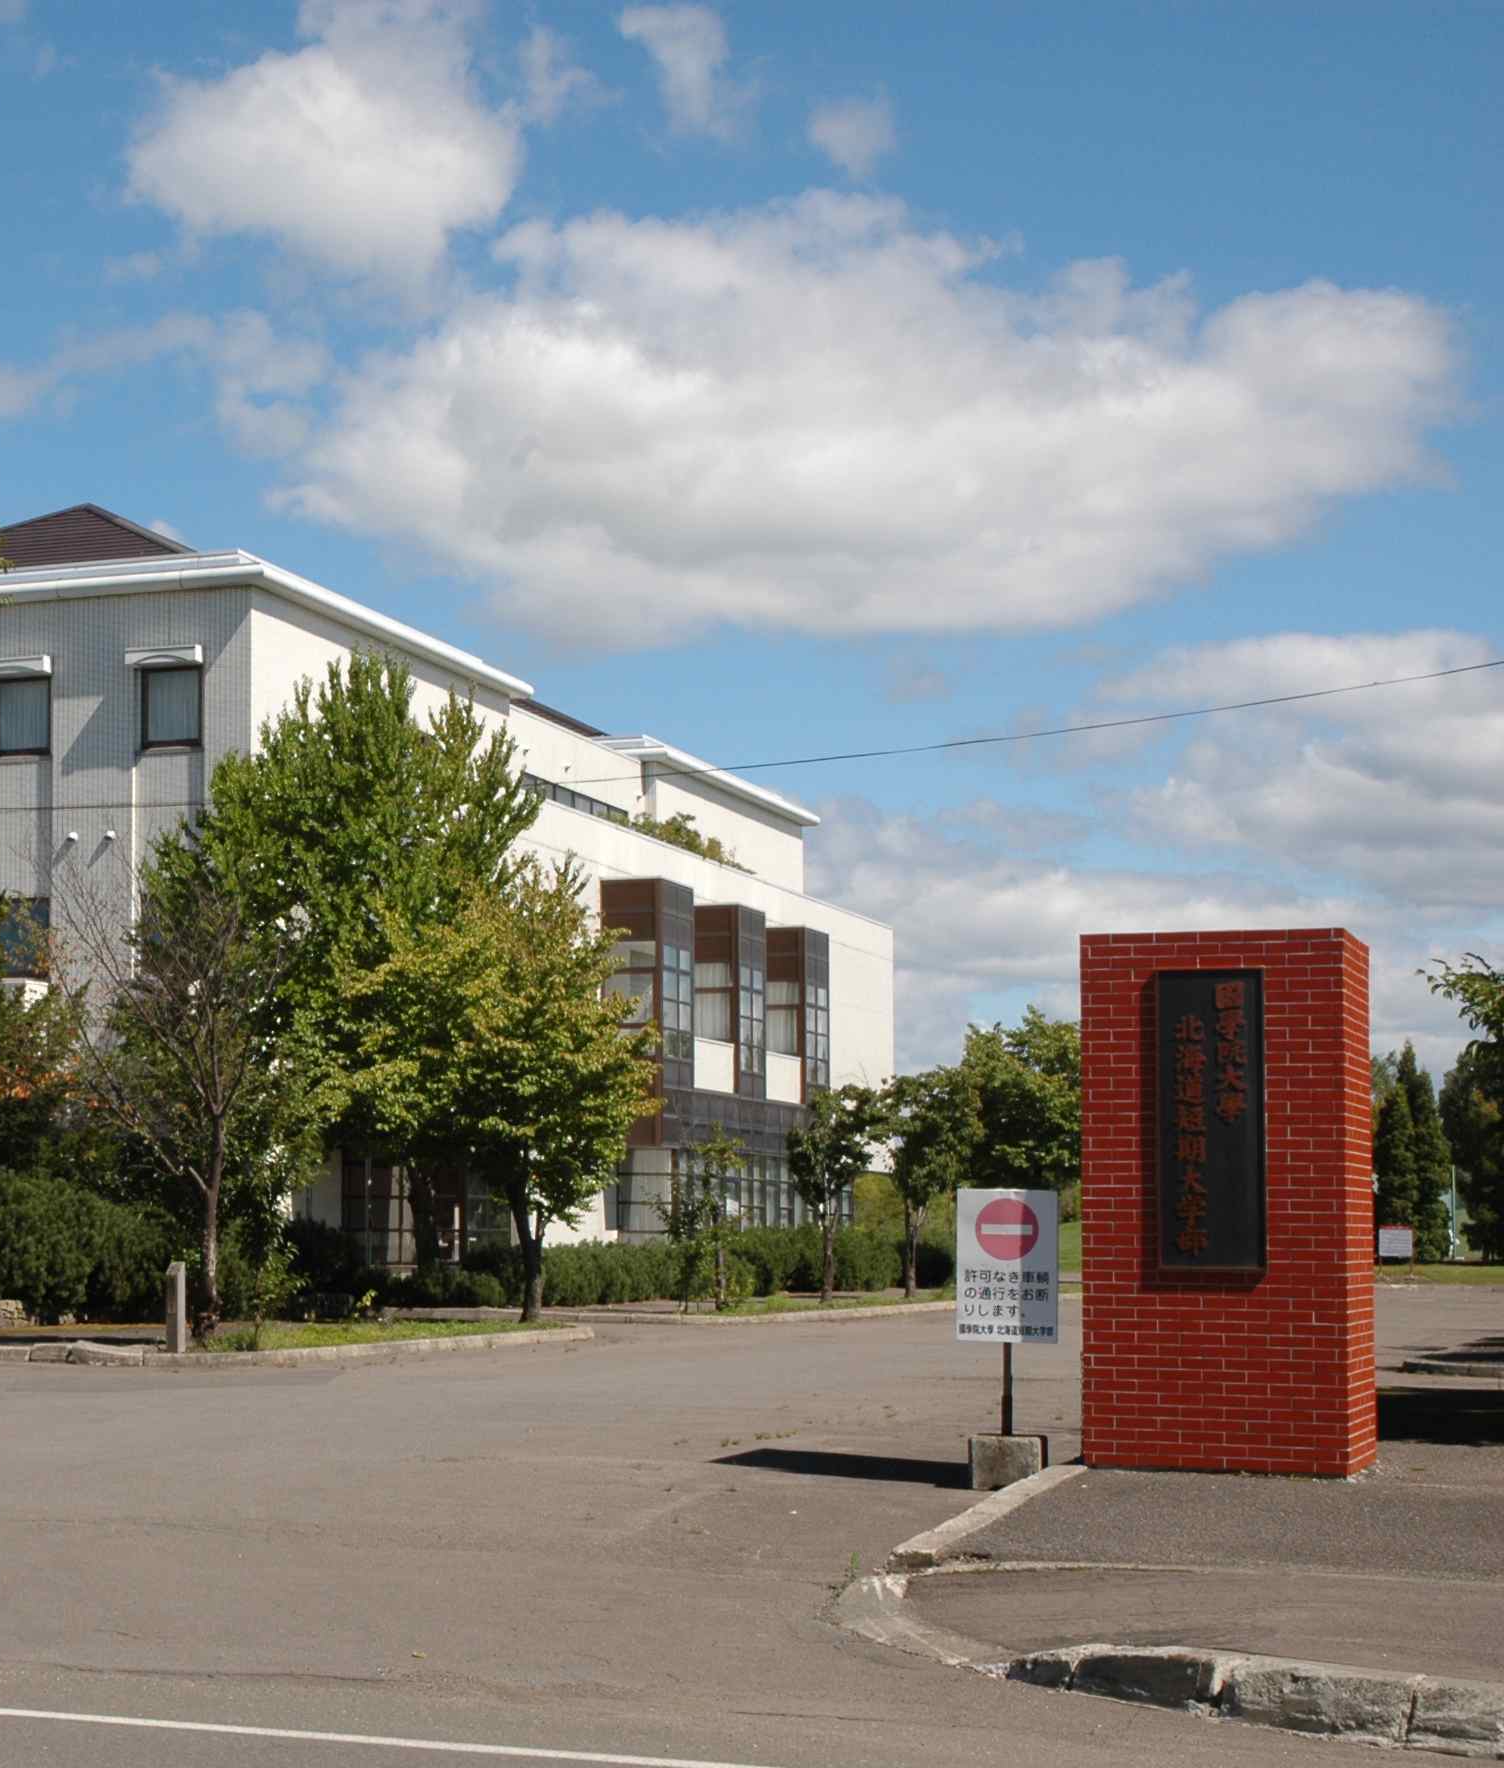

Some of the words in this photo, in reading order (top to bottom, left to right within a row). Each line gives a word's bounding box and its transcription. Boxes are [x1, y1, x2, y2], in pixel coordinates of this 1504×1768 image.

[964, 1287, 1049, 1302] の通行をお断
[964, 1304, 1026, 1318] りします。
